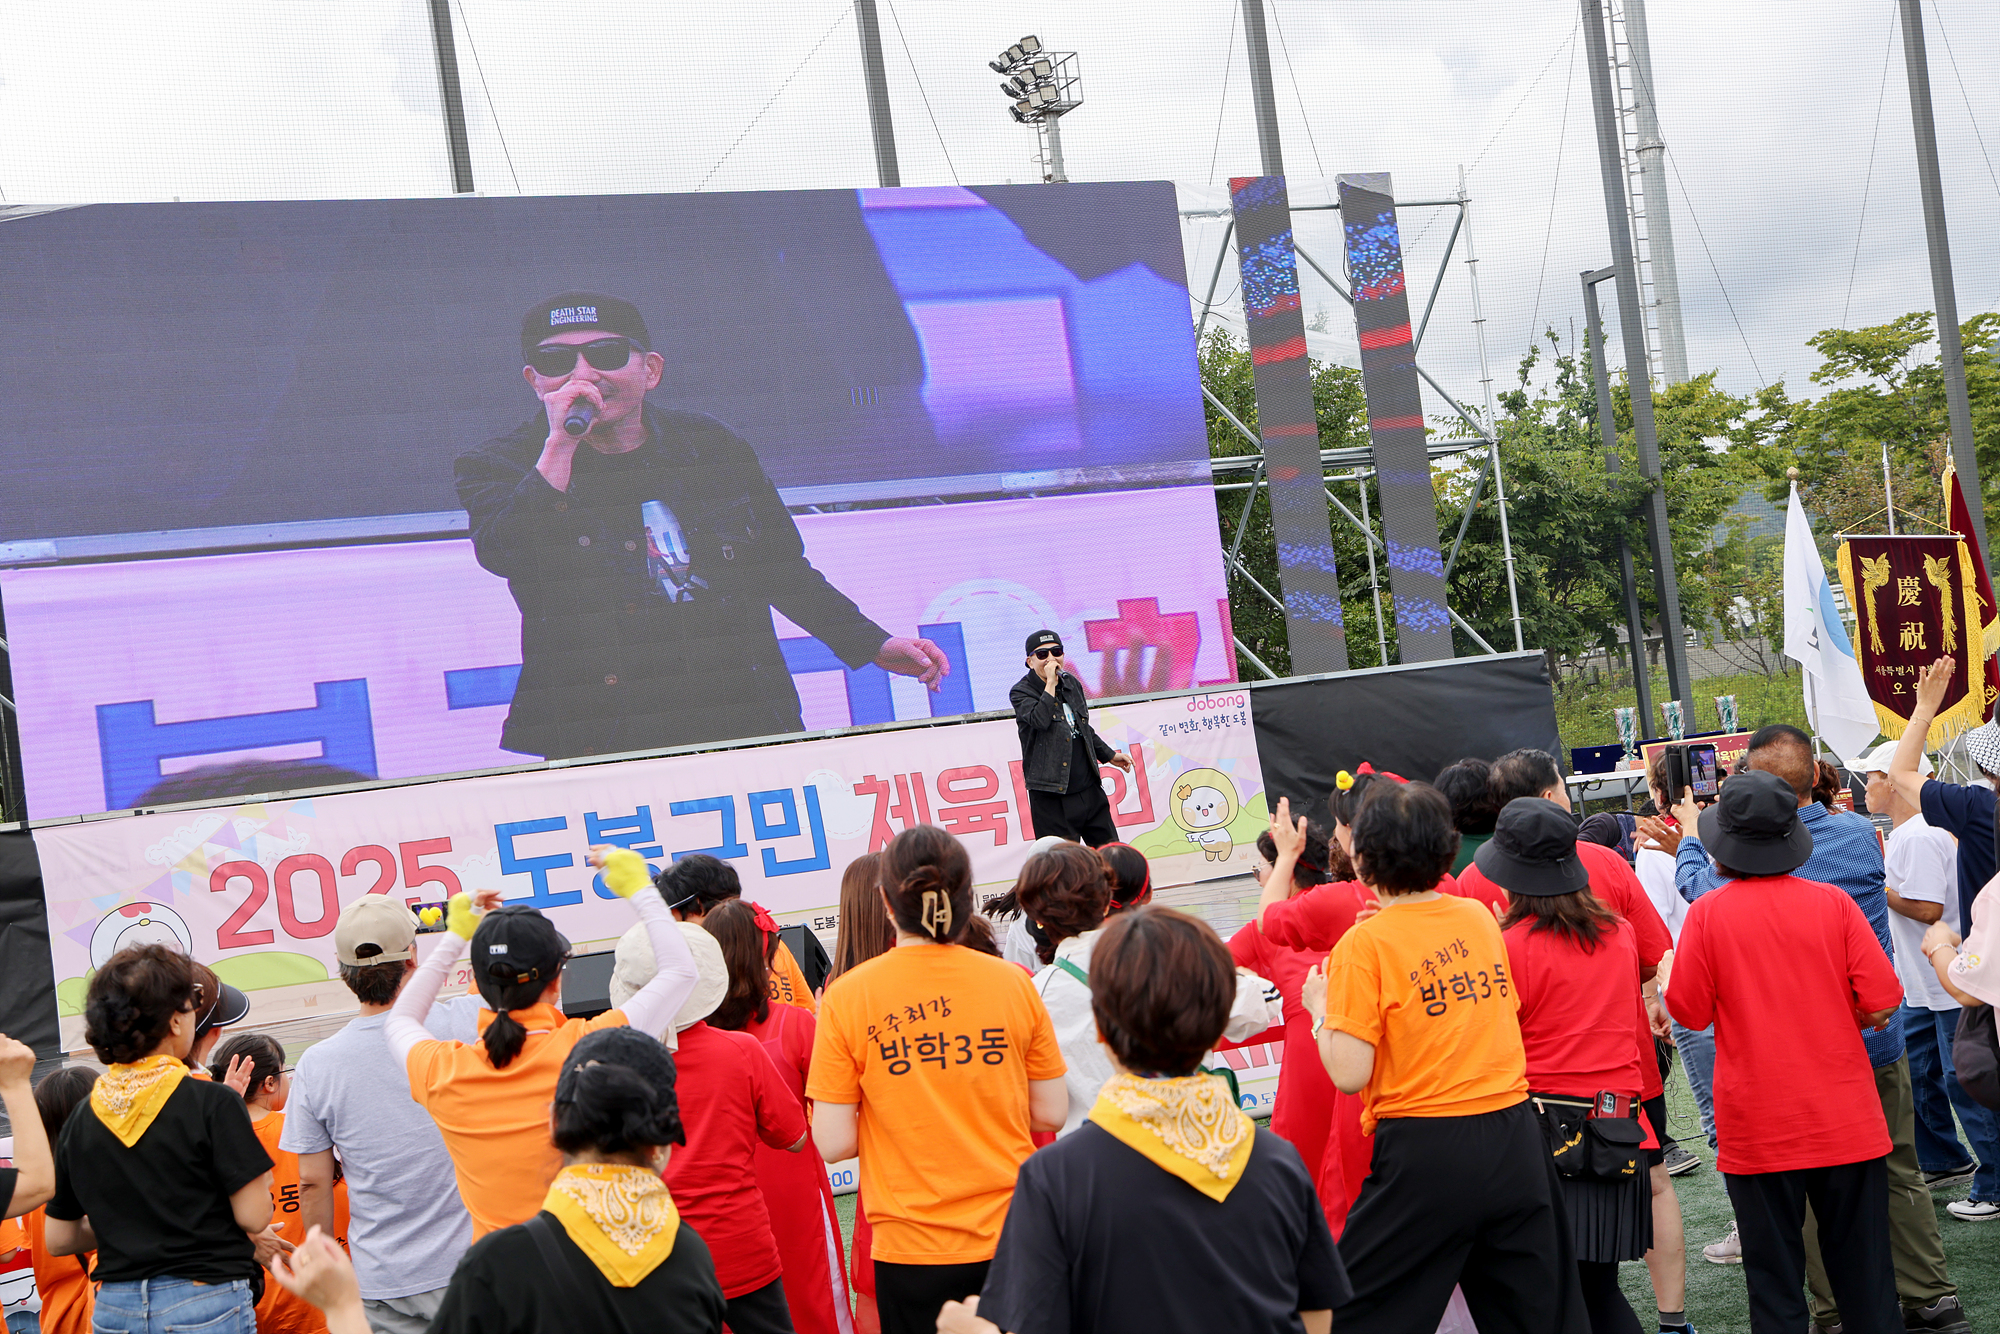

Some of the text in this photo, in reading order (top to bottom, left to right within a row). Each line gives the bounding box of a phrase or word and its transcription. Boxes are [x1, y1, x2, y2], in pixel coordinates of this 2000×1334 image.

[550, 306, 597, 318] DEATH STAR
[550, 315, 598, 326] ENGINEERING
[1875, 665, 1915, 676] 서울특별시
[1187, 695, 1244, 712] dobong
[1159, 724, 1176, 736] 같이
[1202, 714, 1230, 730] 행복한
[1233, 711, 1246, 726] 도봉
[209, 837, 463, 950] 2025
[494, 785, 831, 910] 도봉구민
[1410, 938, 1469, 987] 우주최강
[1420, 964, 1508, 1017] 방학3동
[868, 996, 951, 1043] 우주최강
[880, 1028, 1008, 1075] 방학3동
